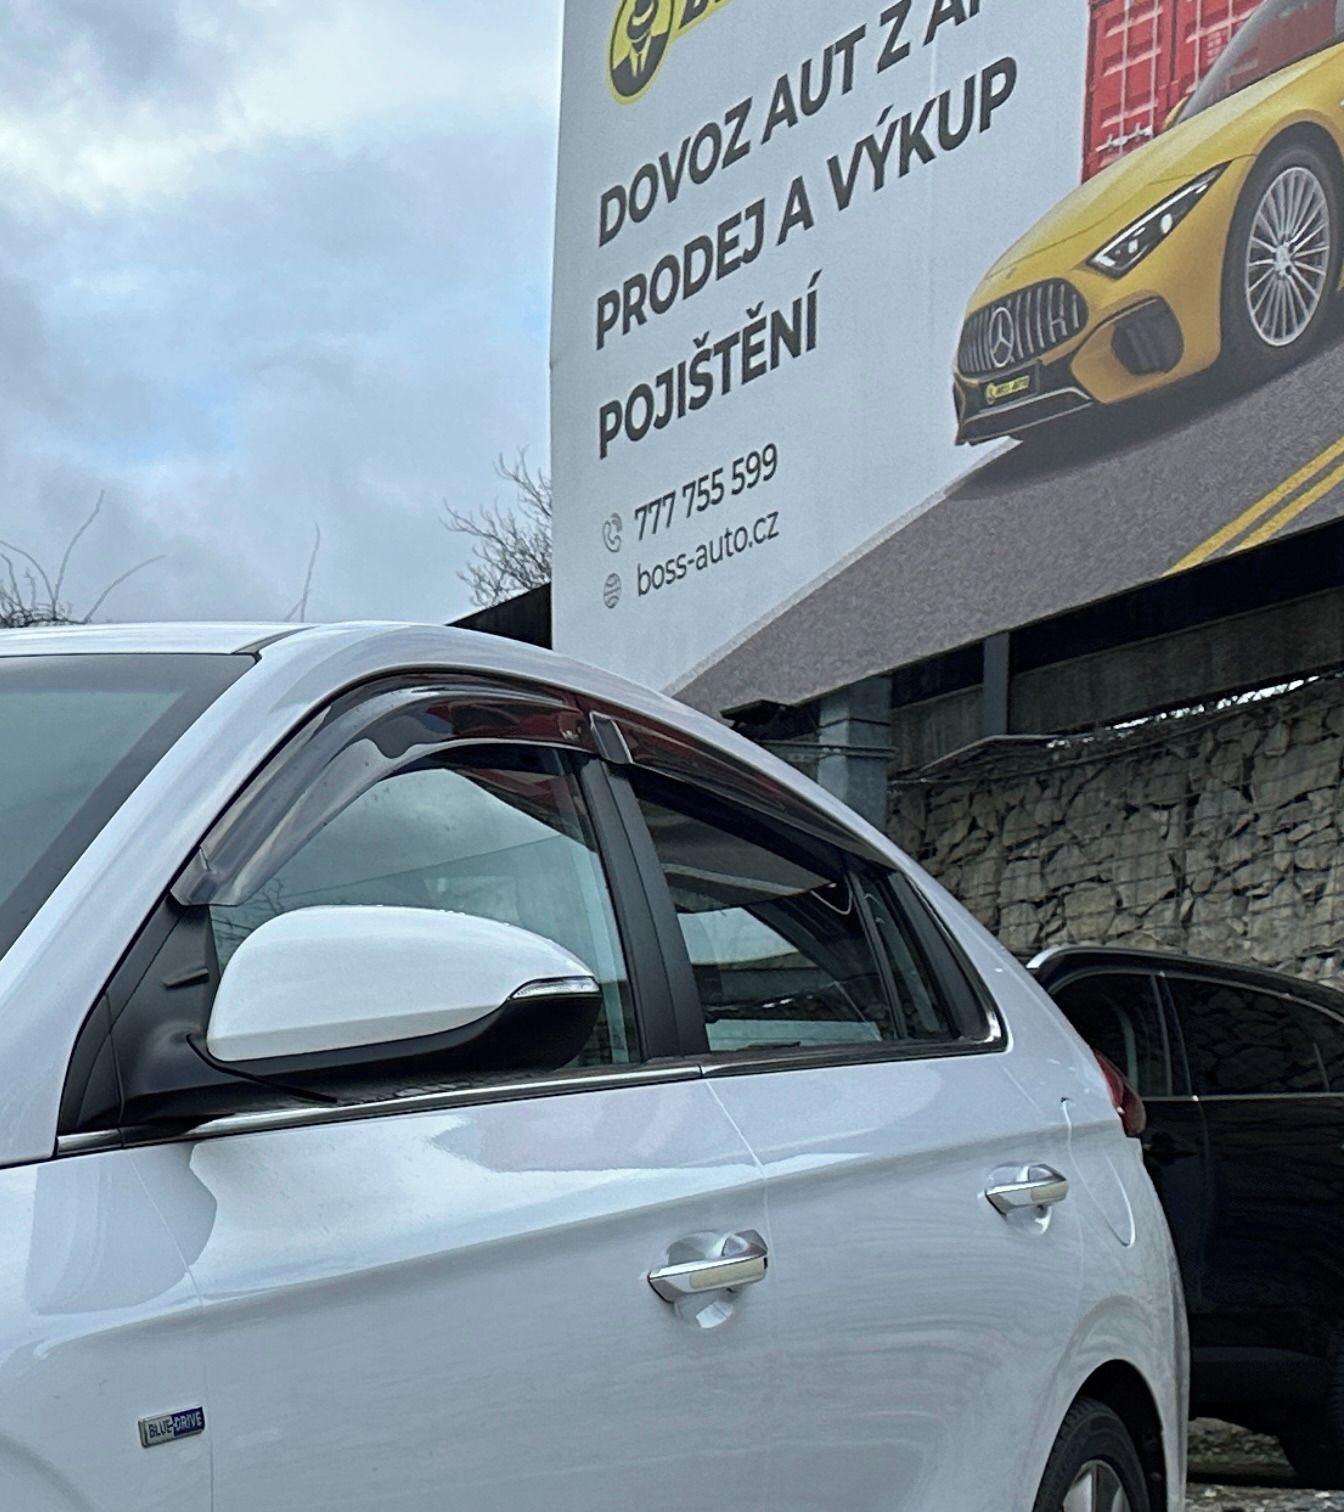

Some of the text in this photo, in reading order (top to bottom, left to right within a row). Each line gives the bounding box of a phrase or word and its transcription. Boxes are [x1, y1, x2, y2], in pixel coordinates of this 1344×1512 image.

[595, 56, 1018, 350] PRODEJ A VÝKUP
[598, 97, 753, 248] DOVOZ
[761, 23, 868, 143] AUT
[877, 0, 913, 74] Z
[598, 269, 823, 461] POJIŠTĚNÍ
[634, 443, 779, 541] 777 755 599
[636, 511, 780, 597] boss-auto.cz
